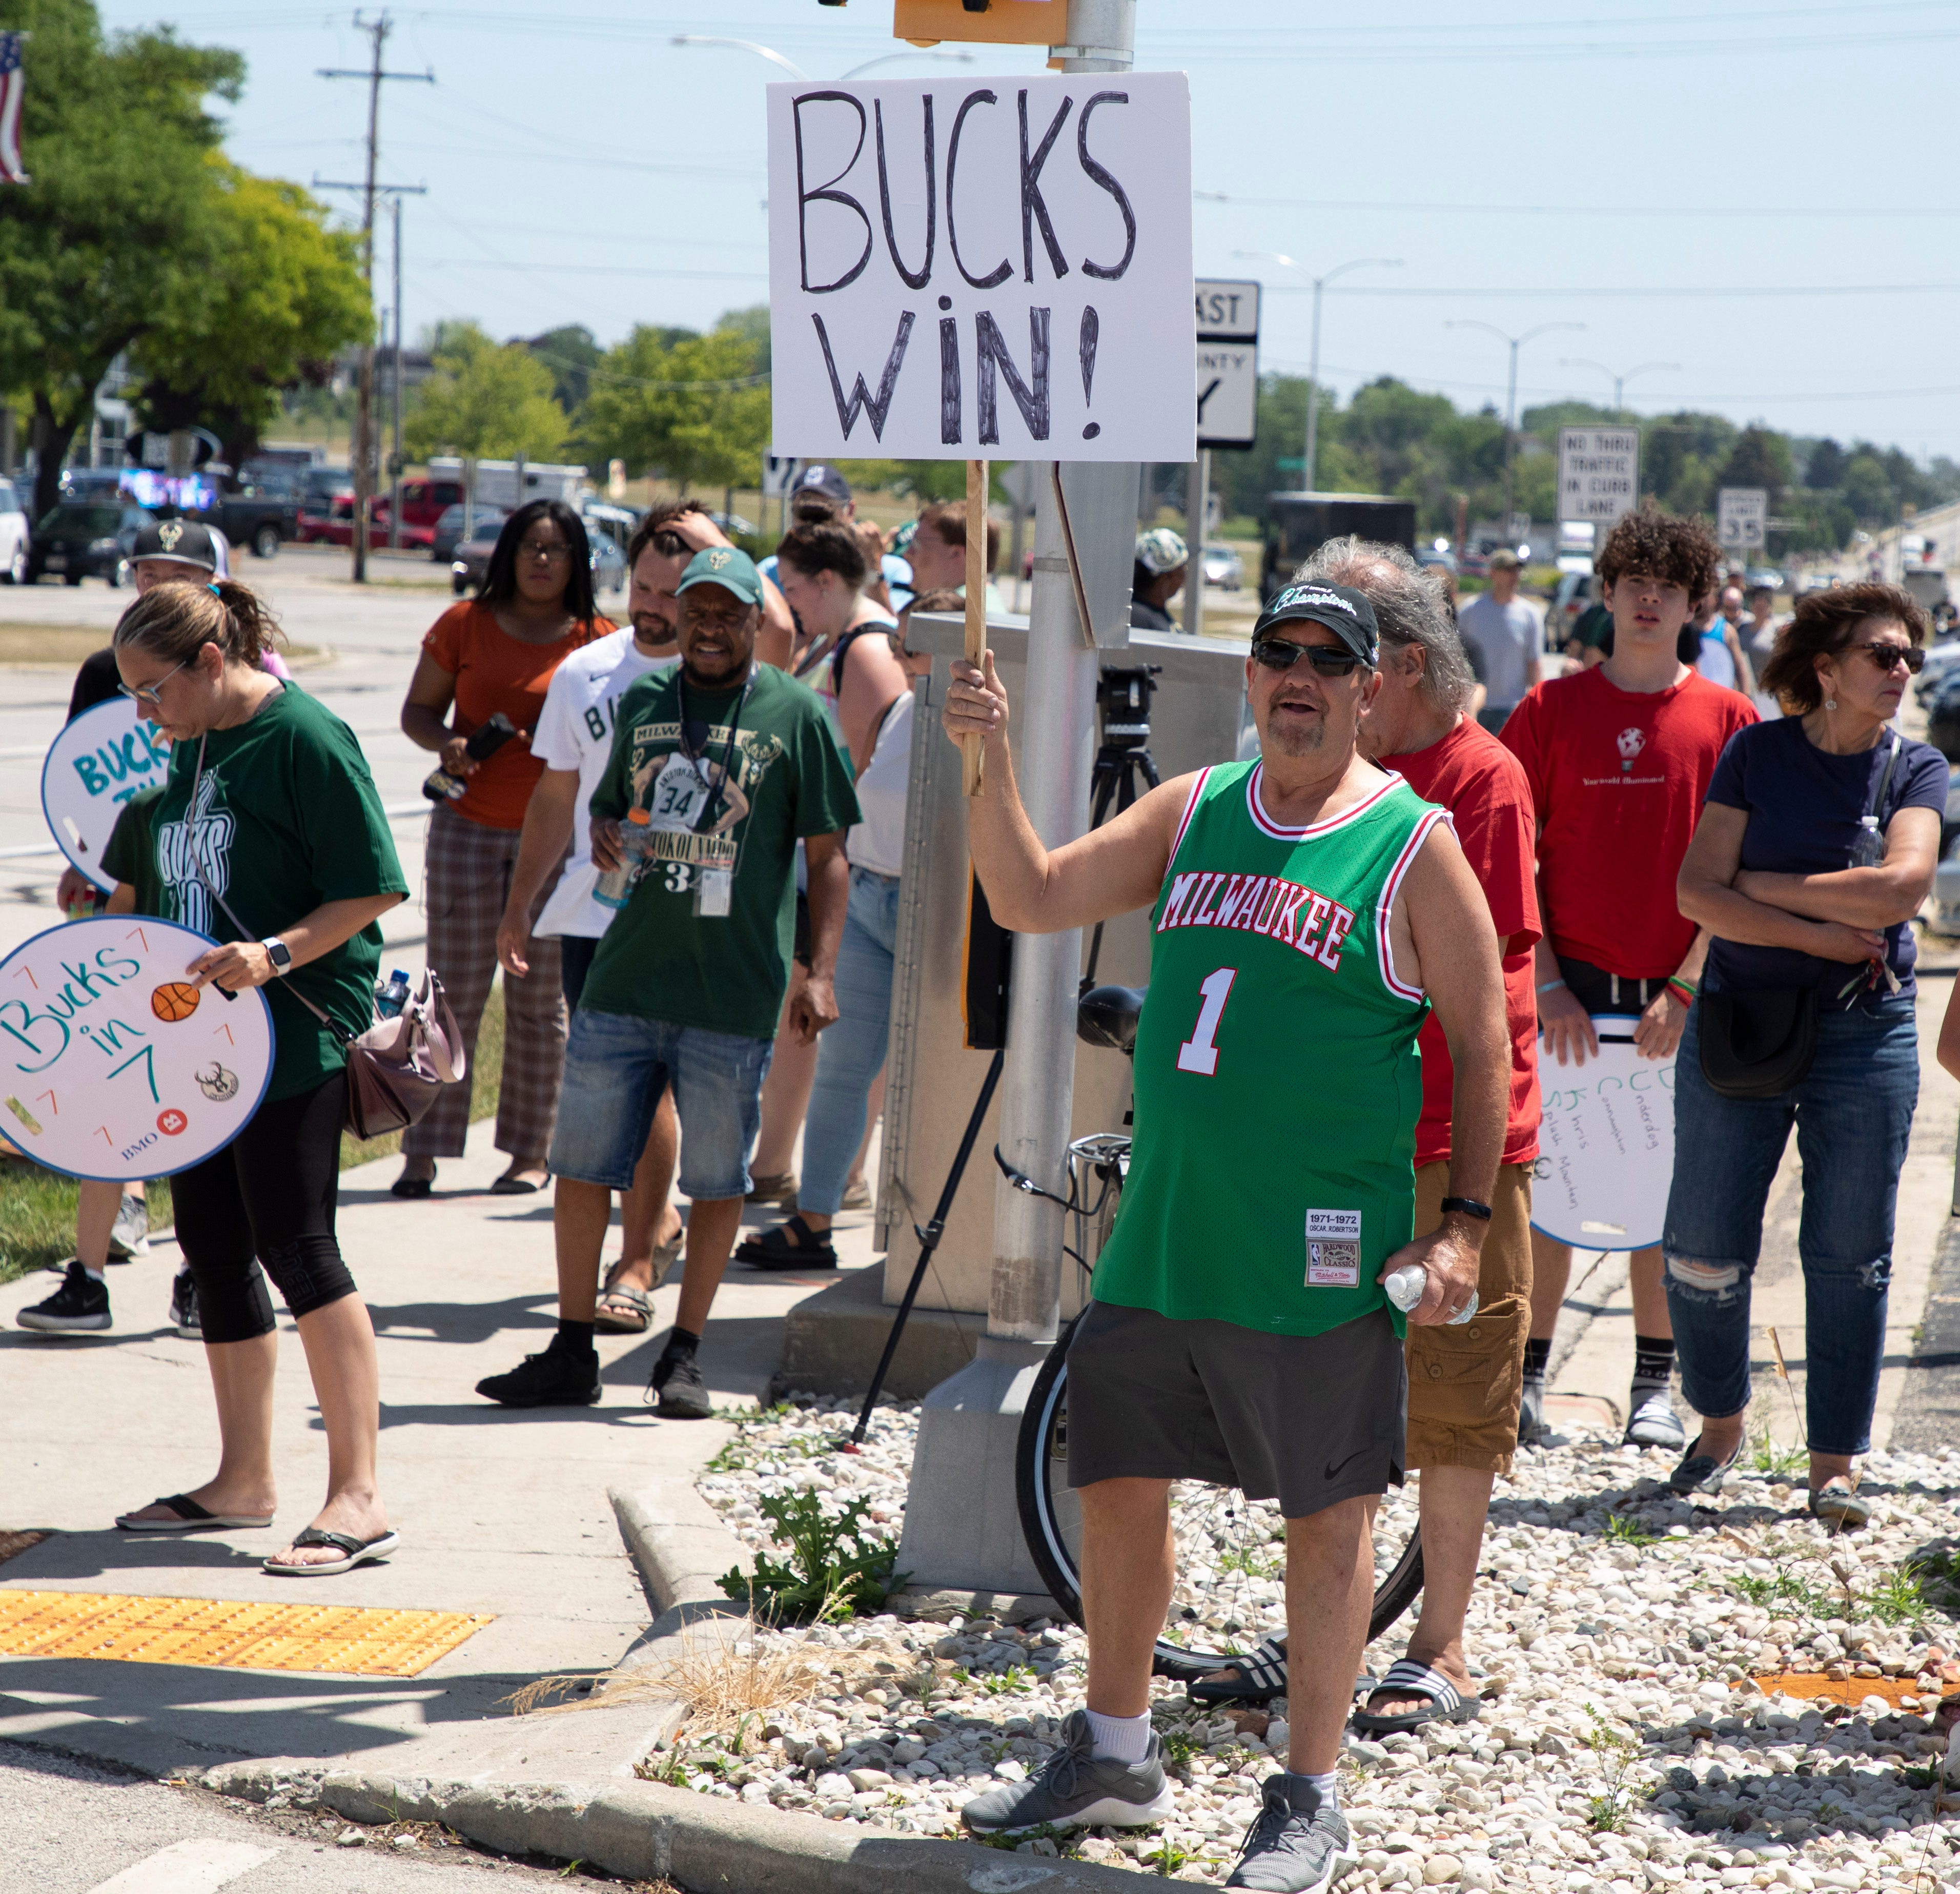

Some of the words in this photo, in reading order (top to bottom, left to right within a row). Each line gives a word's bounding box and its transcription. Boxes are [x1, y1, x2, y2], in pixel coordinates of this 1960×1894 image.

[791, 89, 1136, 294] BUCKS
[1195, 293, 1243, 324] AST
[1567, 437, 1586, 451] NO
[1595, 435, 1633, 453] THRU
[1570, 455, 1628, 473] TRAFFIC
[1567, 478, 1581, 493] IN
[1591, 478, 1630, 495] CURB
[1576, 498, 1615, 515] LANE
[1725, 518, 1761, 542] 35
[72, 720, 170, 797] BUCK
[659, 787, 693, 817] 34
[665, 862, 692, 892] 3
[1155, 870, 1356, 973] MILWAUKEE
[125, 927, 149, 953] 7
[12, 965, 39, 990] 7
[0, 947, 140, 1073] Bucks
[1175, 966, 1239, 1077] 1
[79, 1019, 146, 1056] in
[213, 1023, 234, 1046] 7
[106, 1044, 160, 1104] 7
[35, 1089, 58, 1115] 7
[92, 1125, 113, 1147] 7
[120, 1132, 158, 1162] BMO
[1322, 1243, 1356, 1255] HARDWOOD
[1324, 1256, 1356, 1268] CLASSICS
